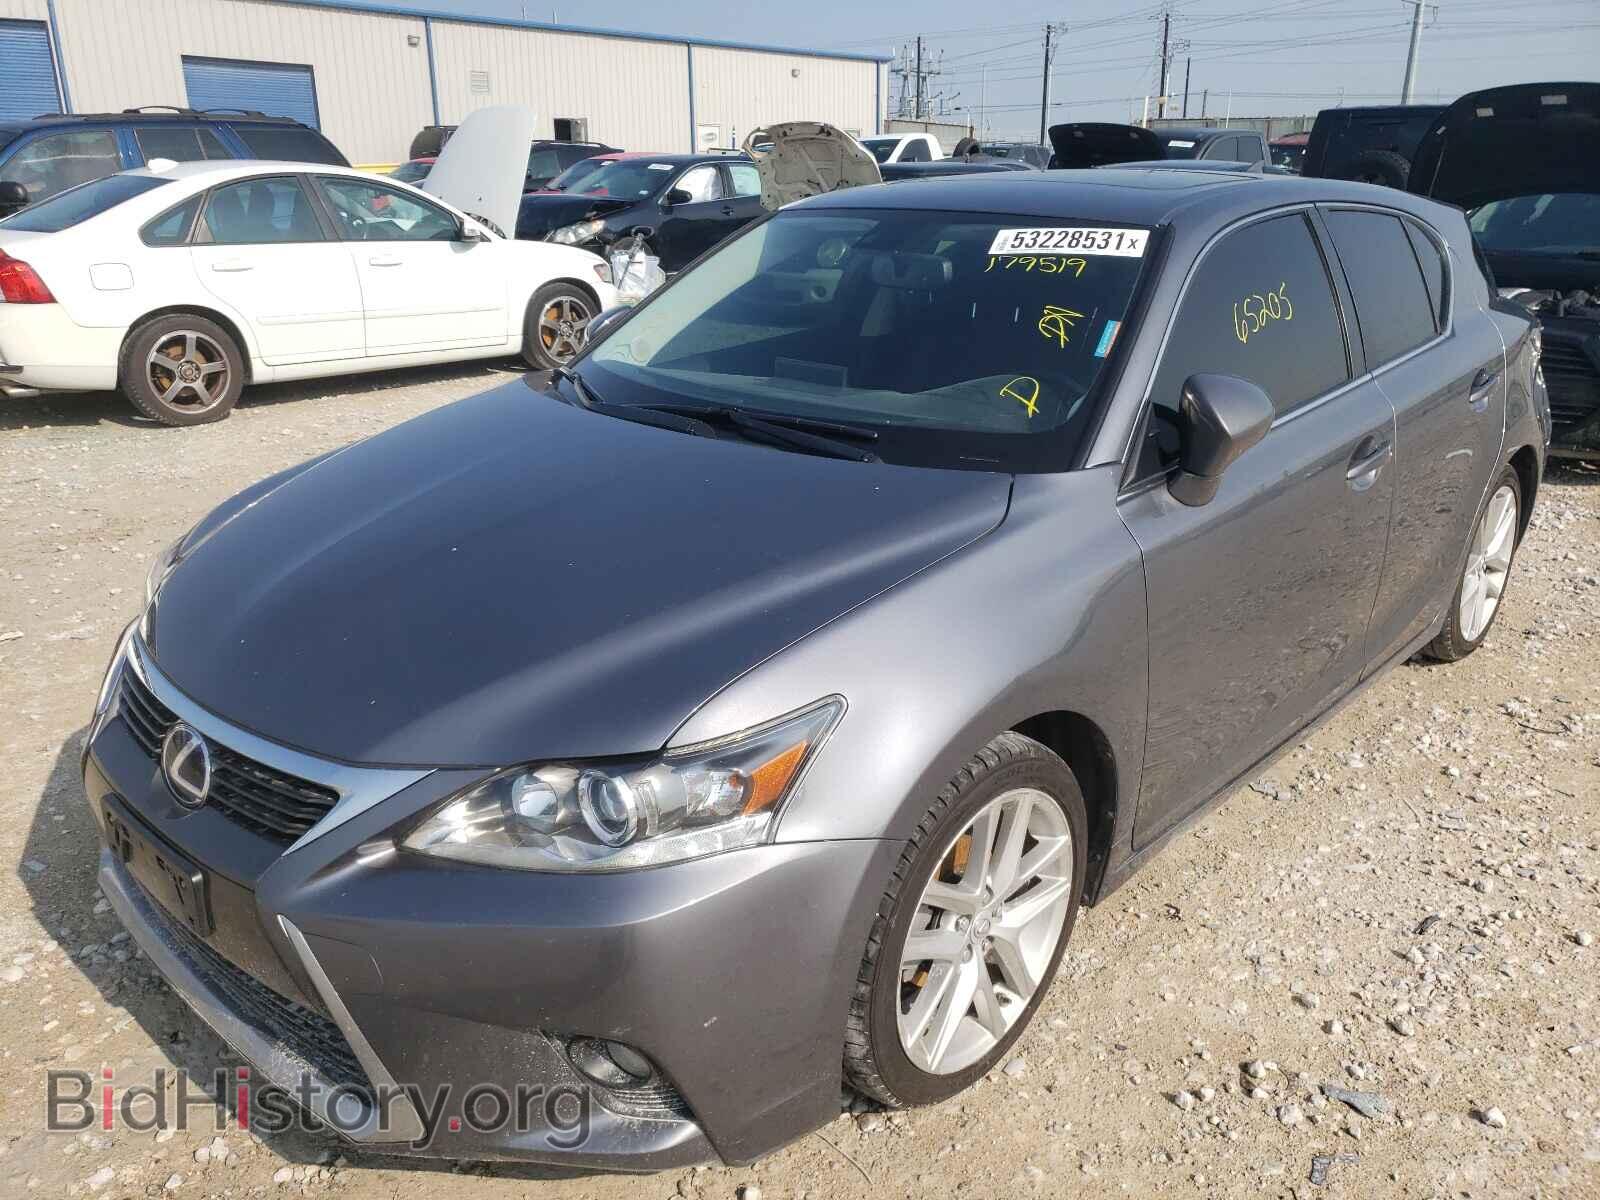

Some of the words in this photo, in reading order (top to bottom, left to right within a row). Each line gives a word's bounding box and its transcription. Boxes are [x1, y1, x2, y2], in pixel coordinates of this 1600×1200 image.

[1010, 230, 1125, 250] 53228531
[984, 255, 1087, 278] 179519
[1234, 281, 1293, 344] 65205
